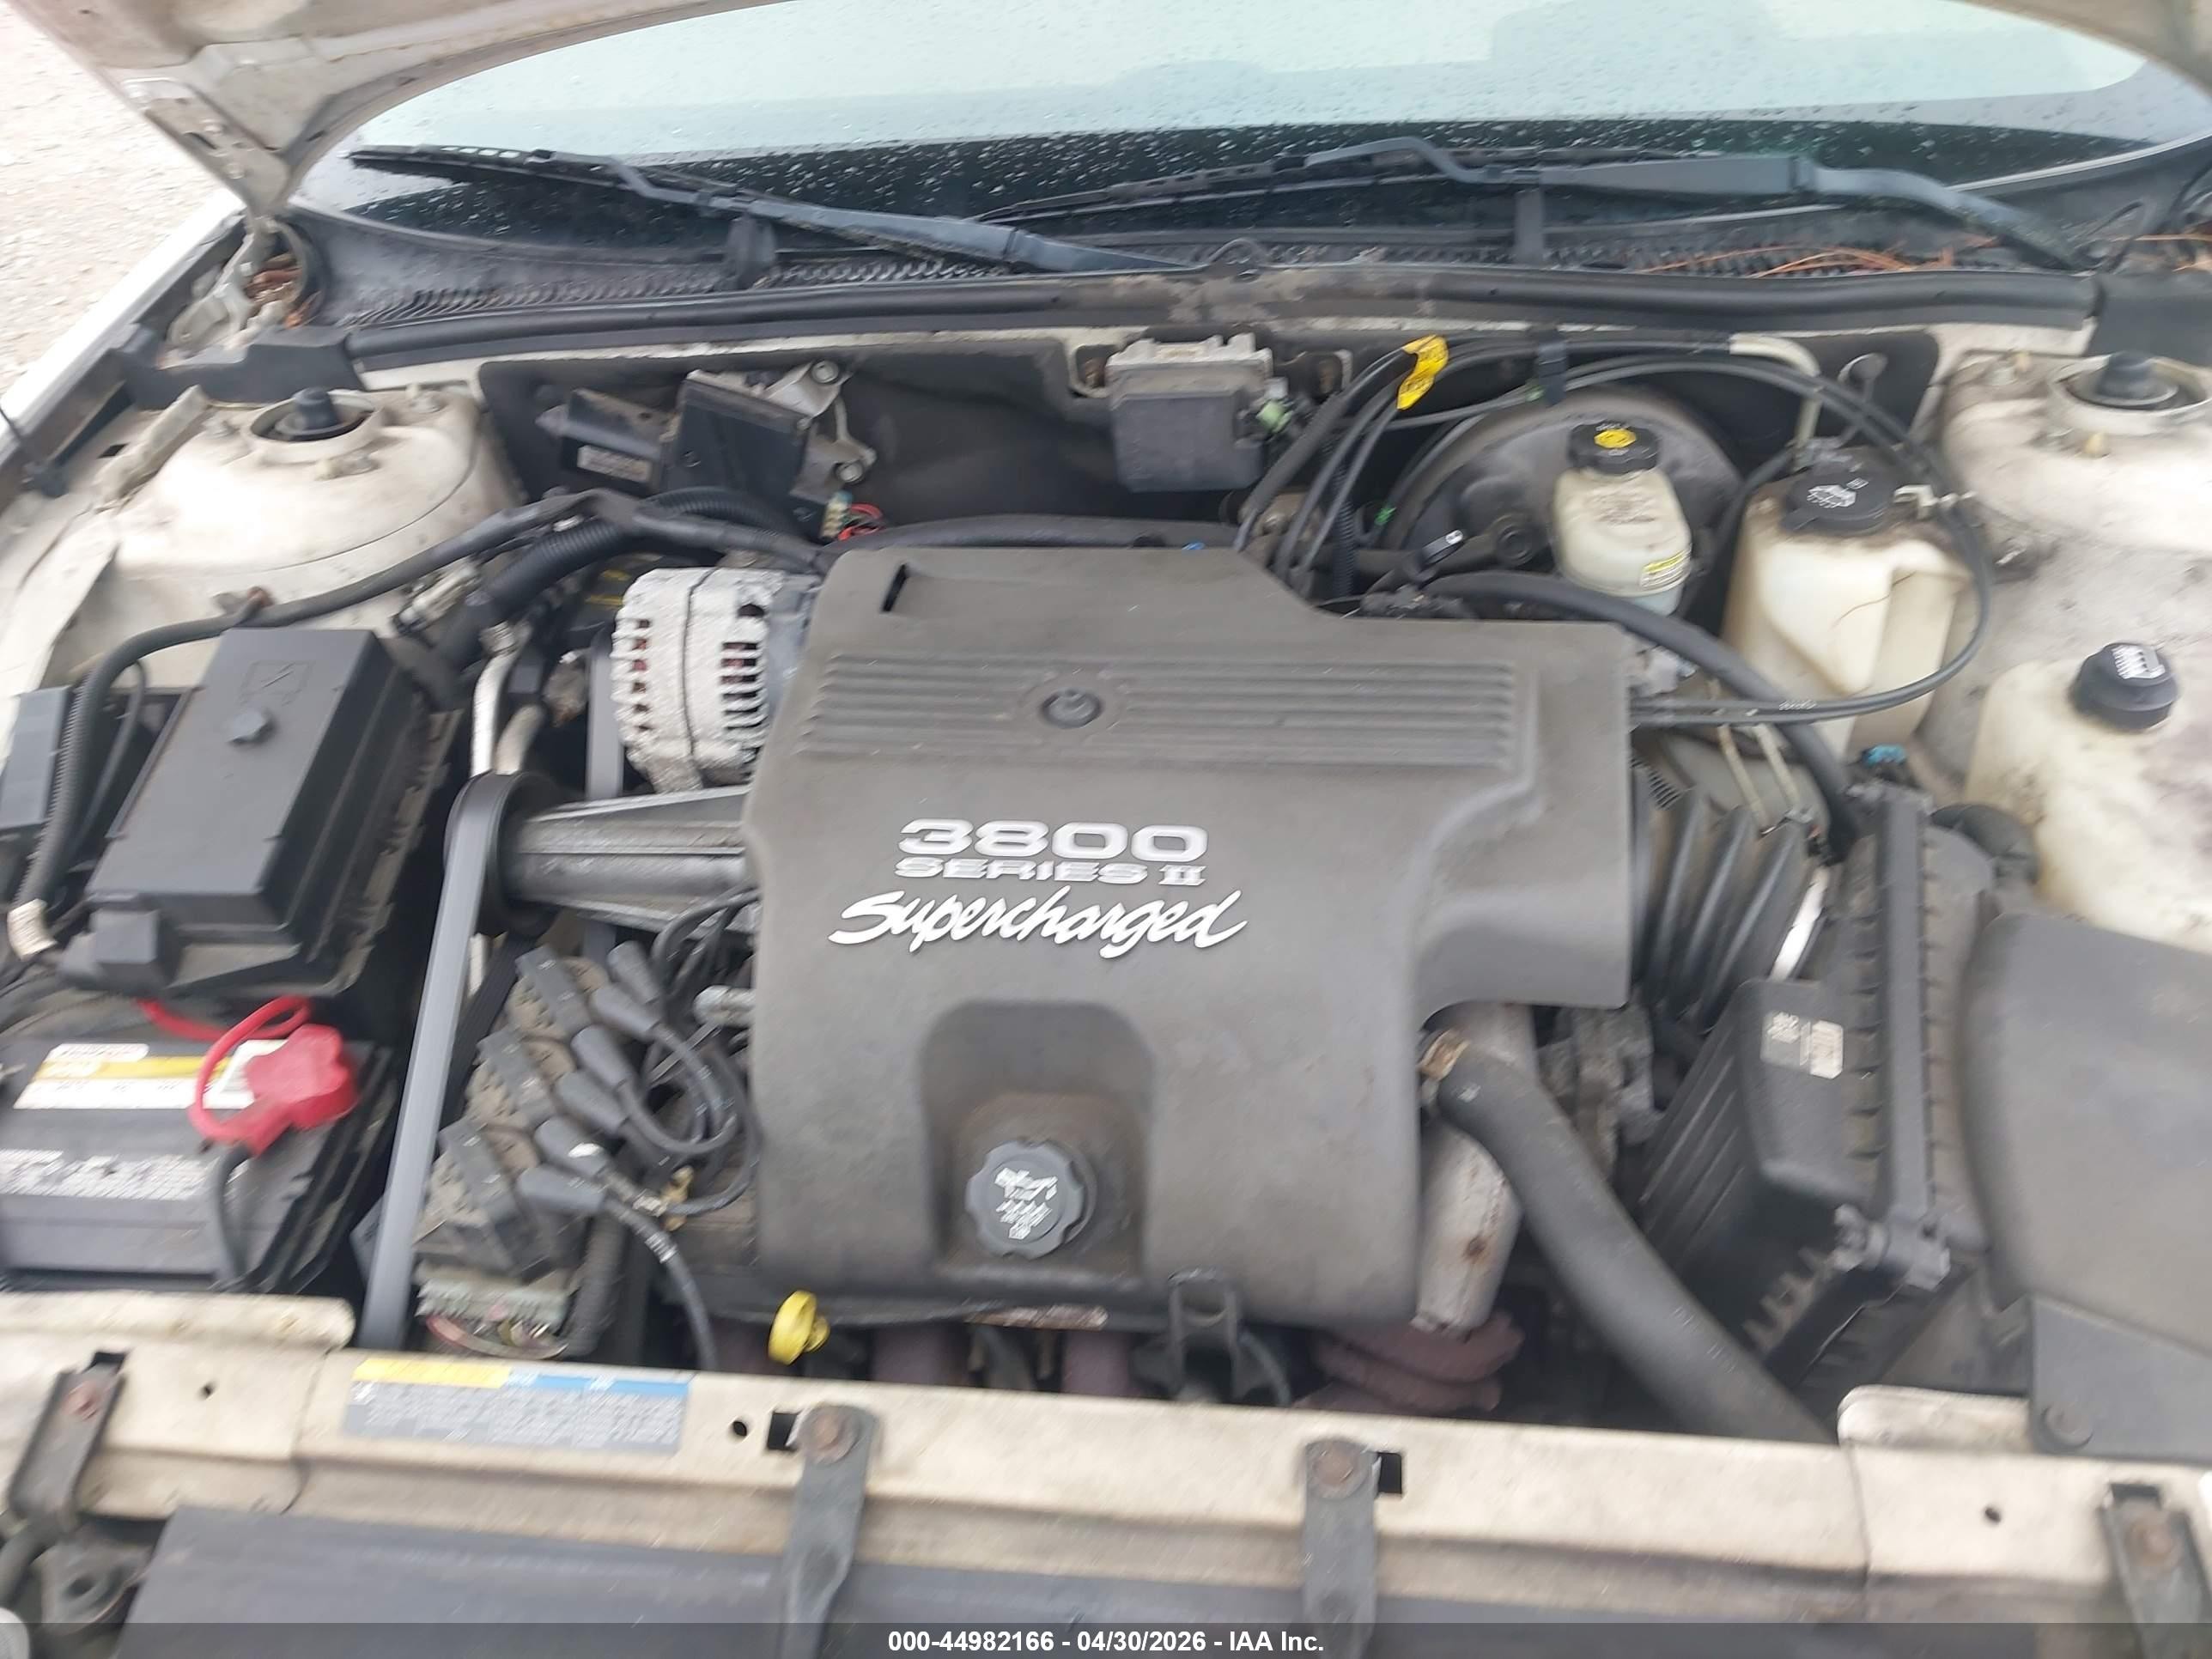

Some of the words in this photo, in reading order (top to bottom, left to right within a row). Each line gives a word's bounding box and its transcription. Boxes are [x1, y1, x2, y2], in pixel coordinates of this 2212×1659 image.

[898, 818, 1208, 862] 3800
[895, 857, 1148, 884] SERIES
[1158, 864, 1206, 886] II
[827, 884, 1248, 959] Supercharged
